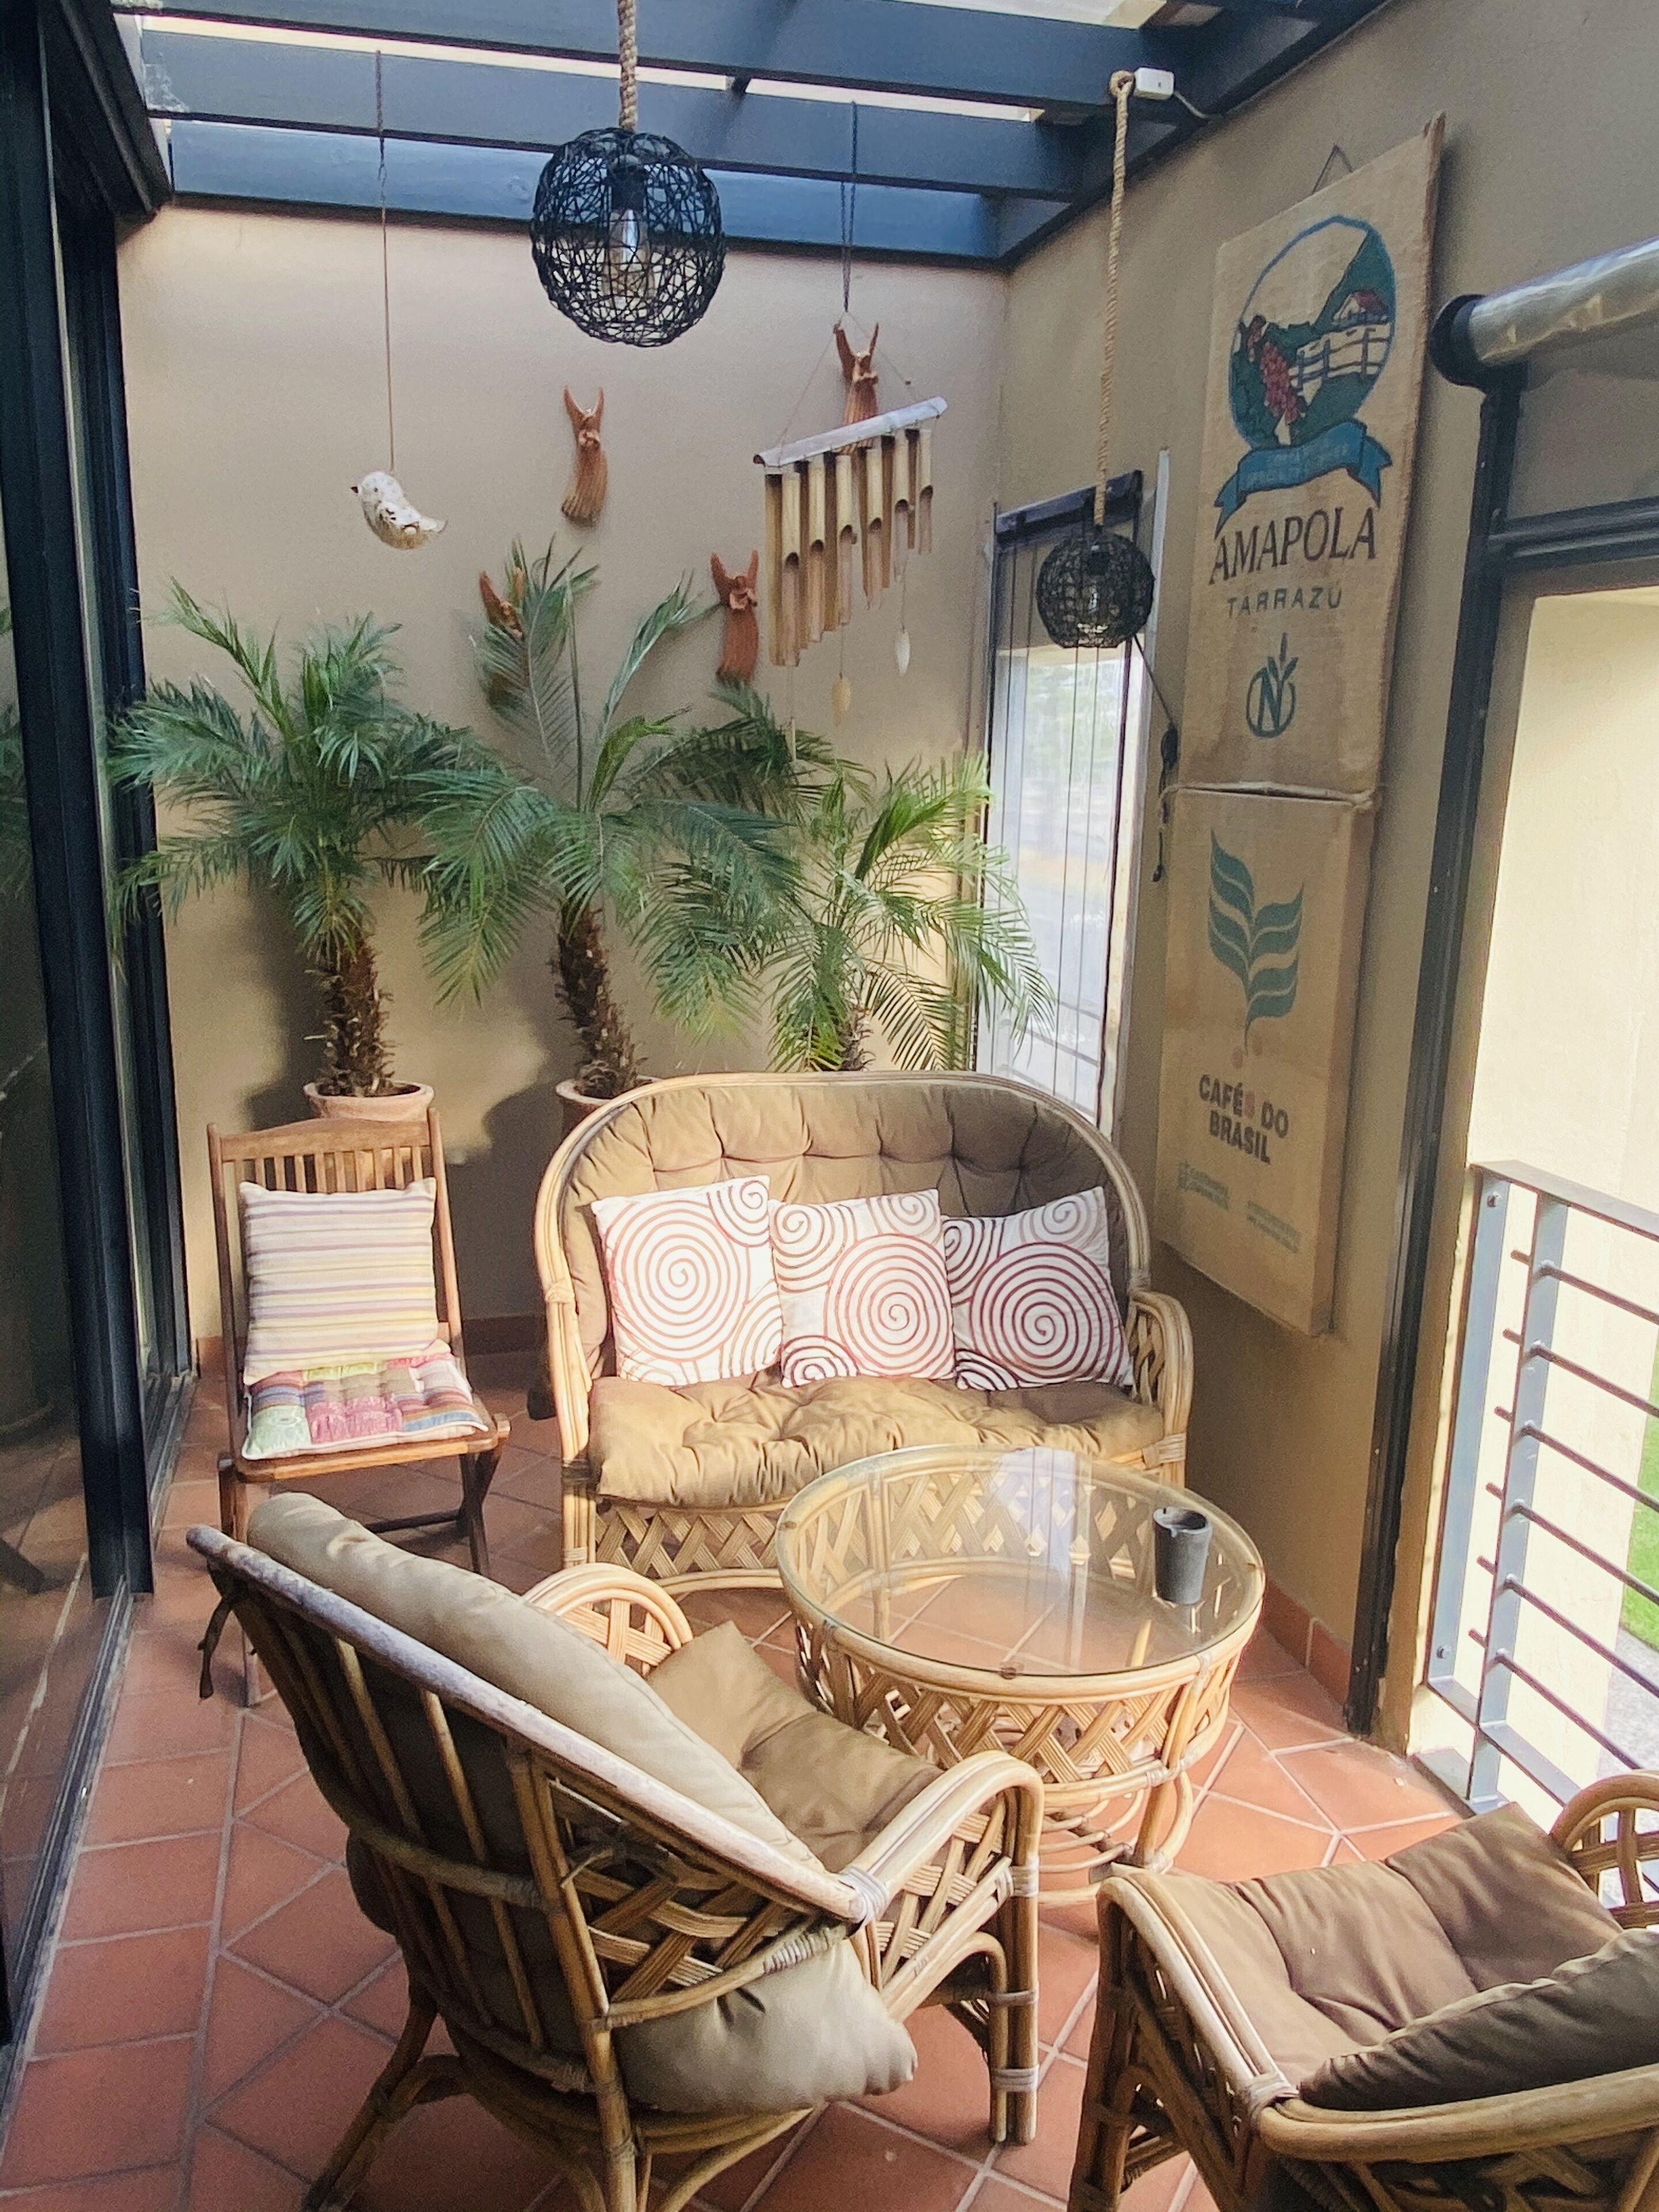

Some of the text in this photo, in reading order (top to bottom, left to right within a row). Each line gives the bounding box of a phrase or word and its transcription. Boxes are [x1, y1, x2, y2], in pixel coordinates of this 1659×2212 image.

[1209, 506, 1377, 586] AMAPOLA
[1209, 1109, 1271, 1165] BRASIL
[1260, 1101, 1289, 1138] DO
